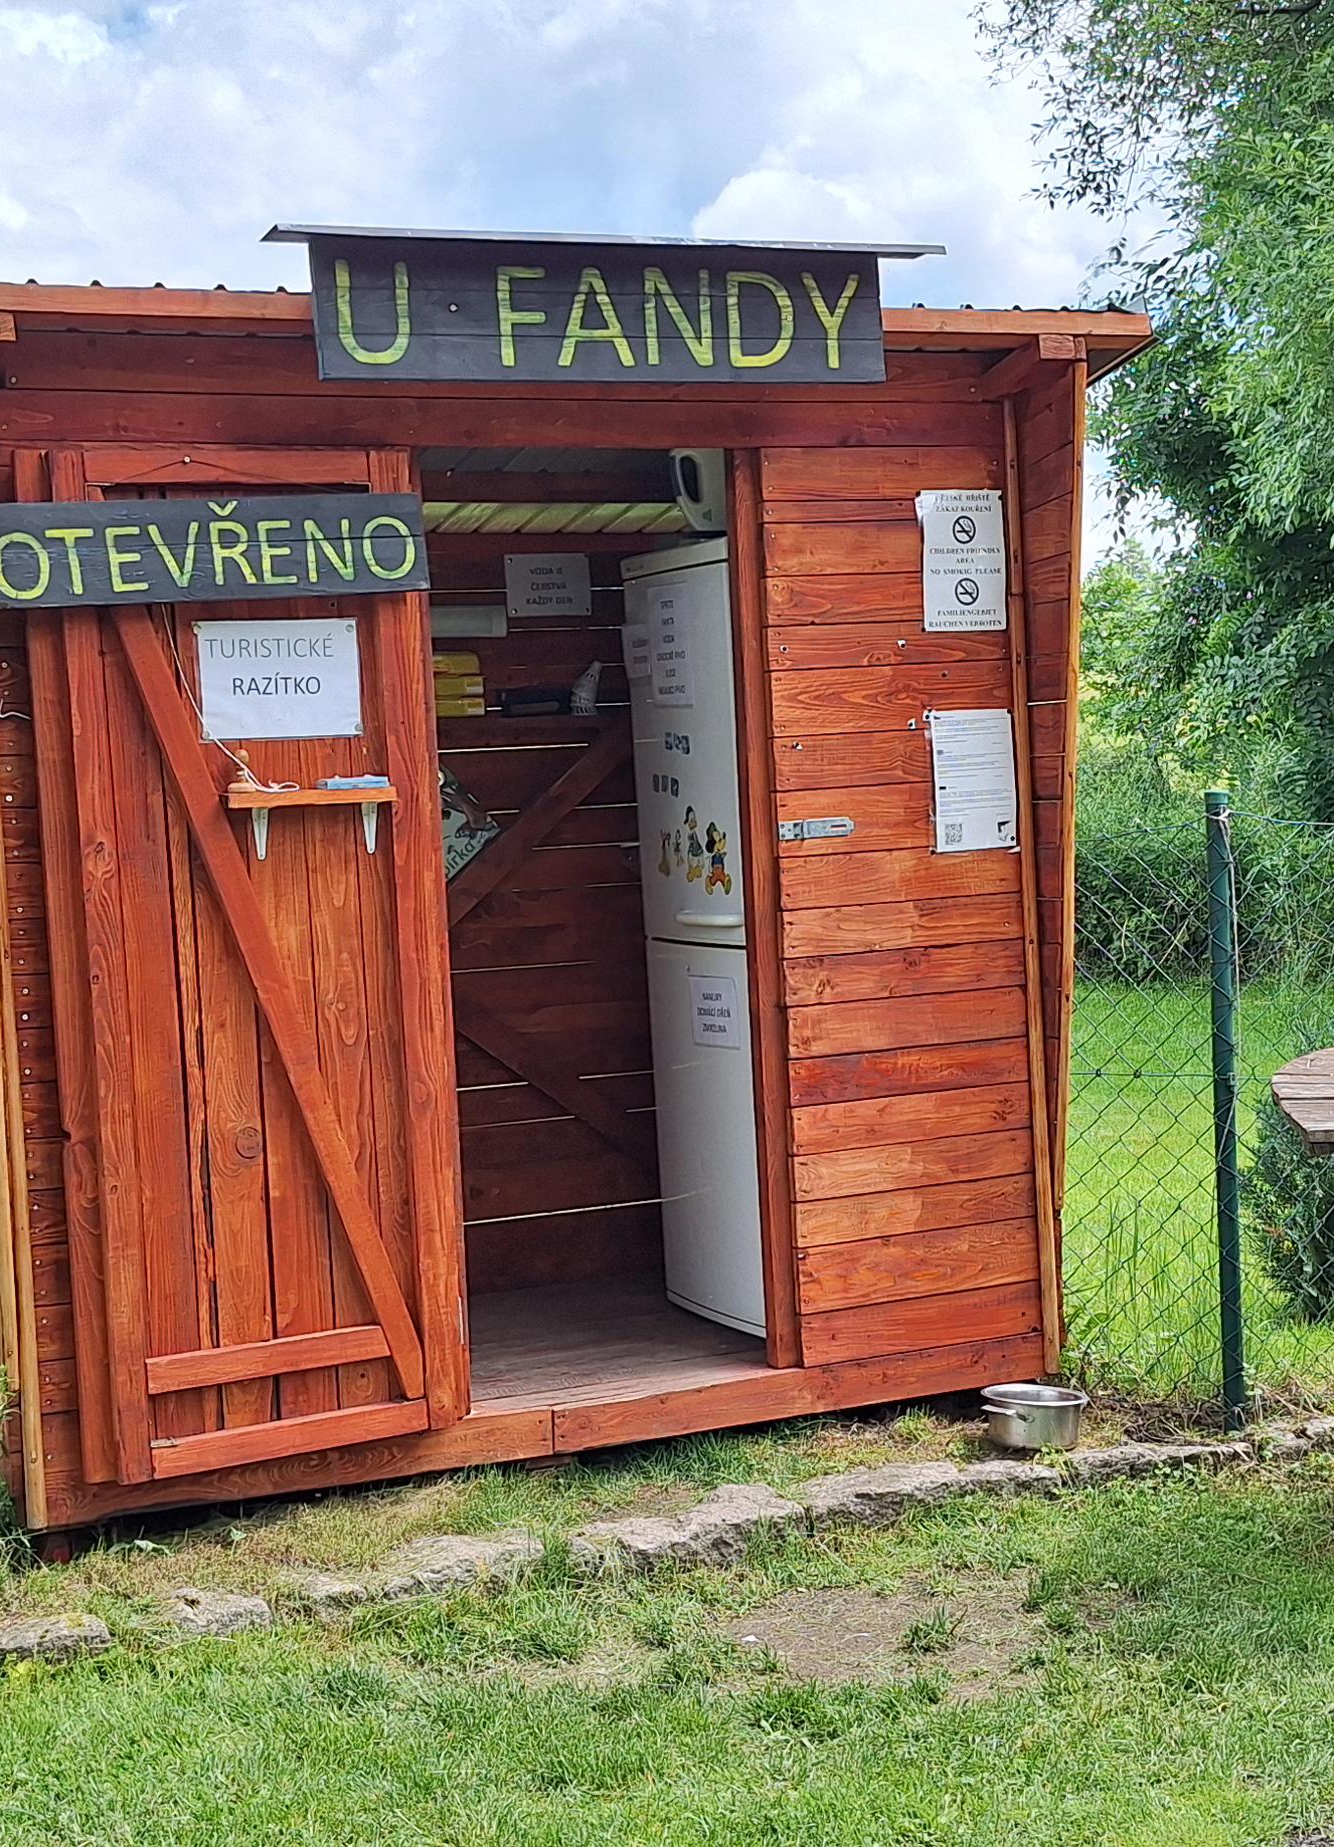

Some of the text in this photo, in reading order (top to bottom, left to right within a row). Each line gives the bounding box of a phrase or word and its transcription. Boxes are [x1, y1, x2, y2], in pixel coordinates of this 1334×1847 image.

[334, 258, 860, 370] U FANDY
[204, 633, 335, 660] TURISTICKÉ
[232, 672, 322, 696] RAZÍTKO
